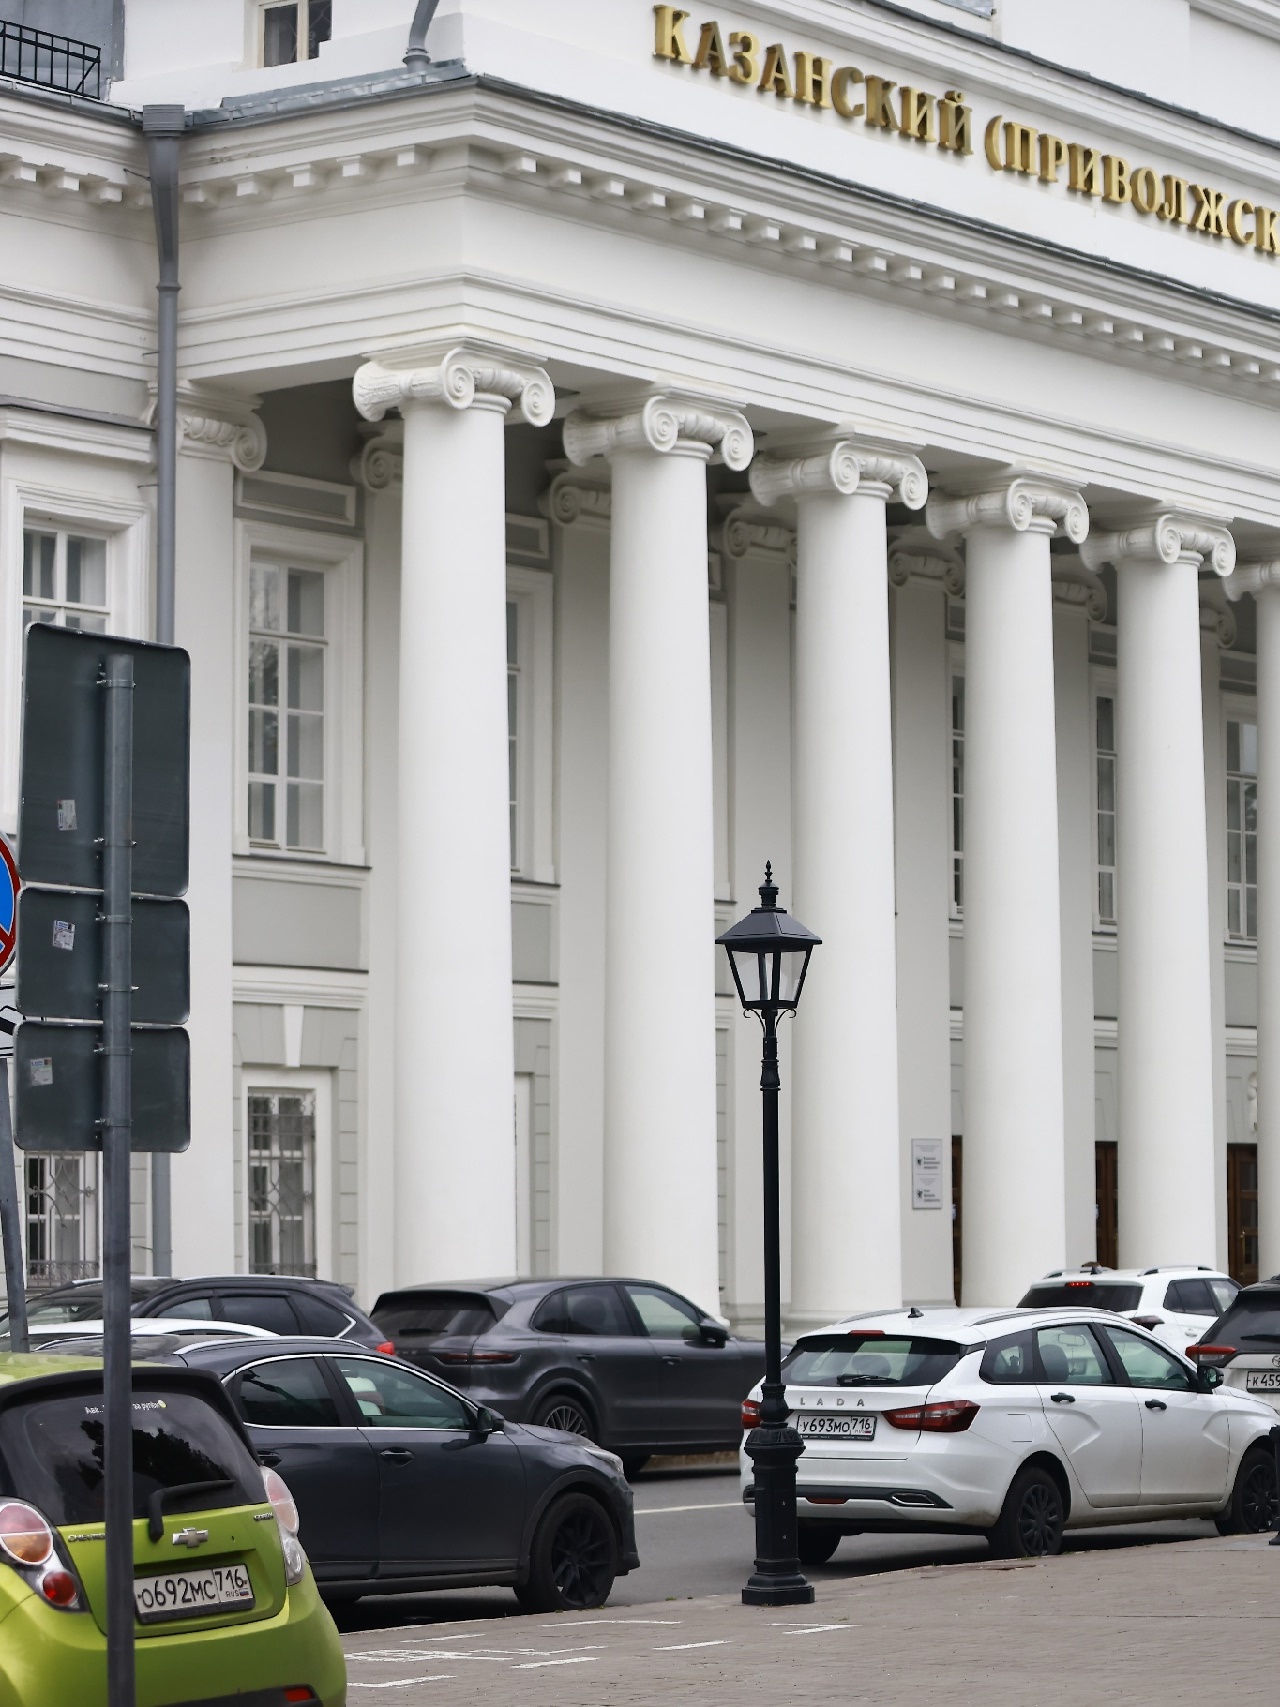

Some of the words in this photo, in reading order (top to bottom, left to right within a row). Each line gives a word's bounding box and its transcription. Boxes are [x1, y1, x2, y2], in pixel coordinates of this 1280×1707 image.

[653, 4, 974, 156] КАЗАНСКИЙ
[800, 1397, 865, 1407] LADA
[215, 1568, 244, 1592] 716
